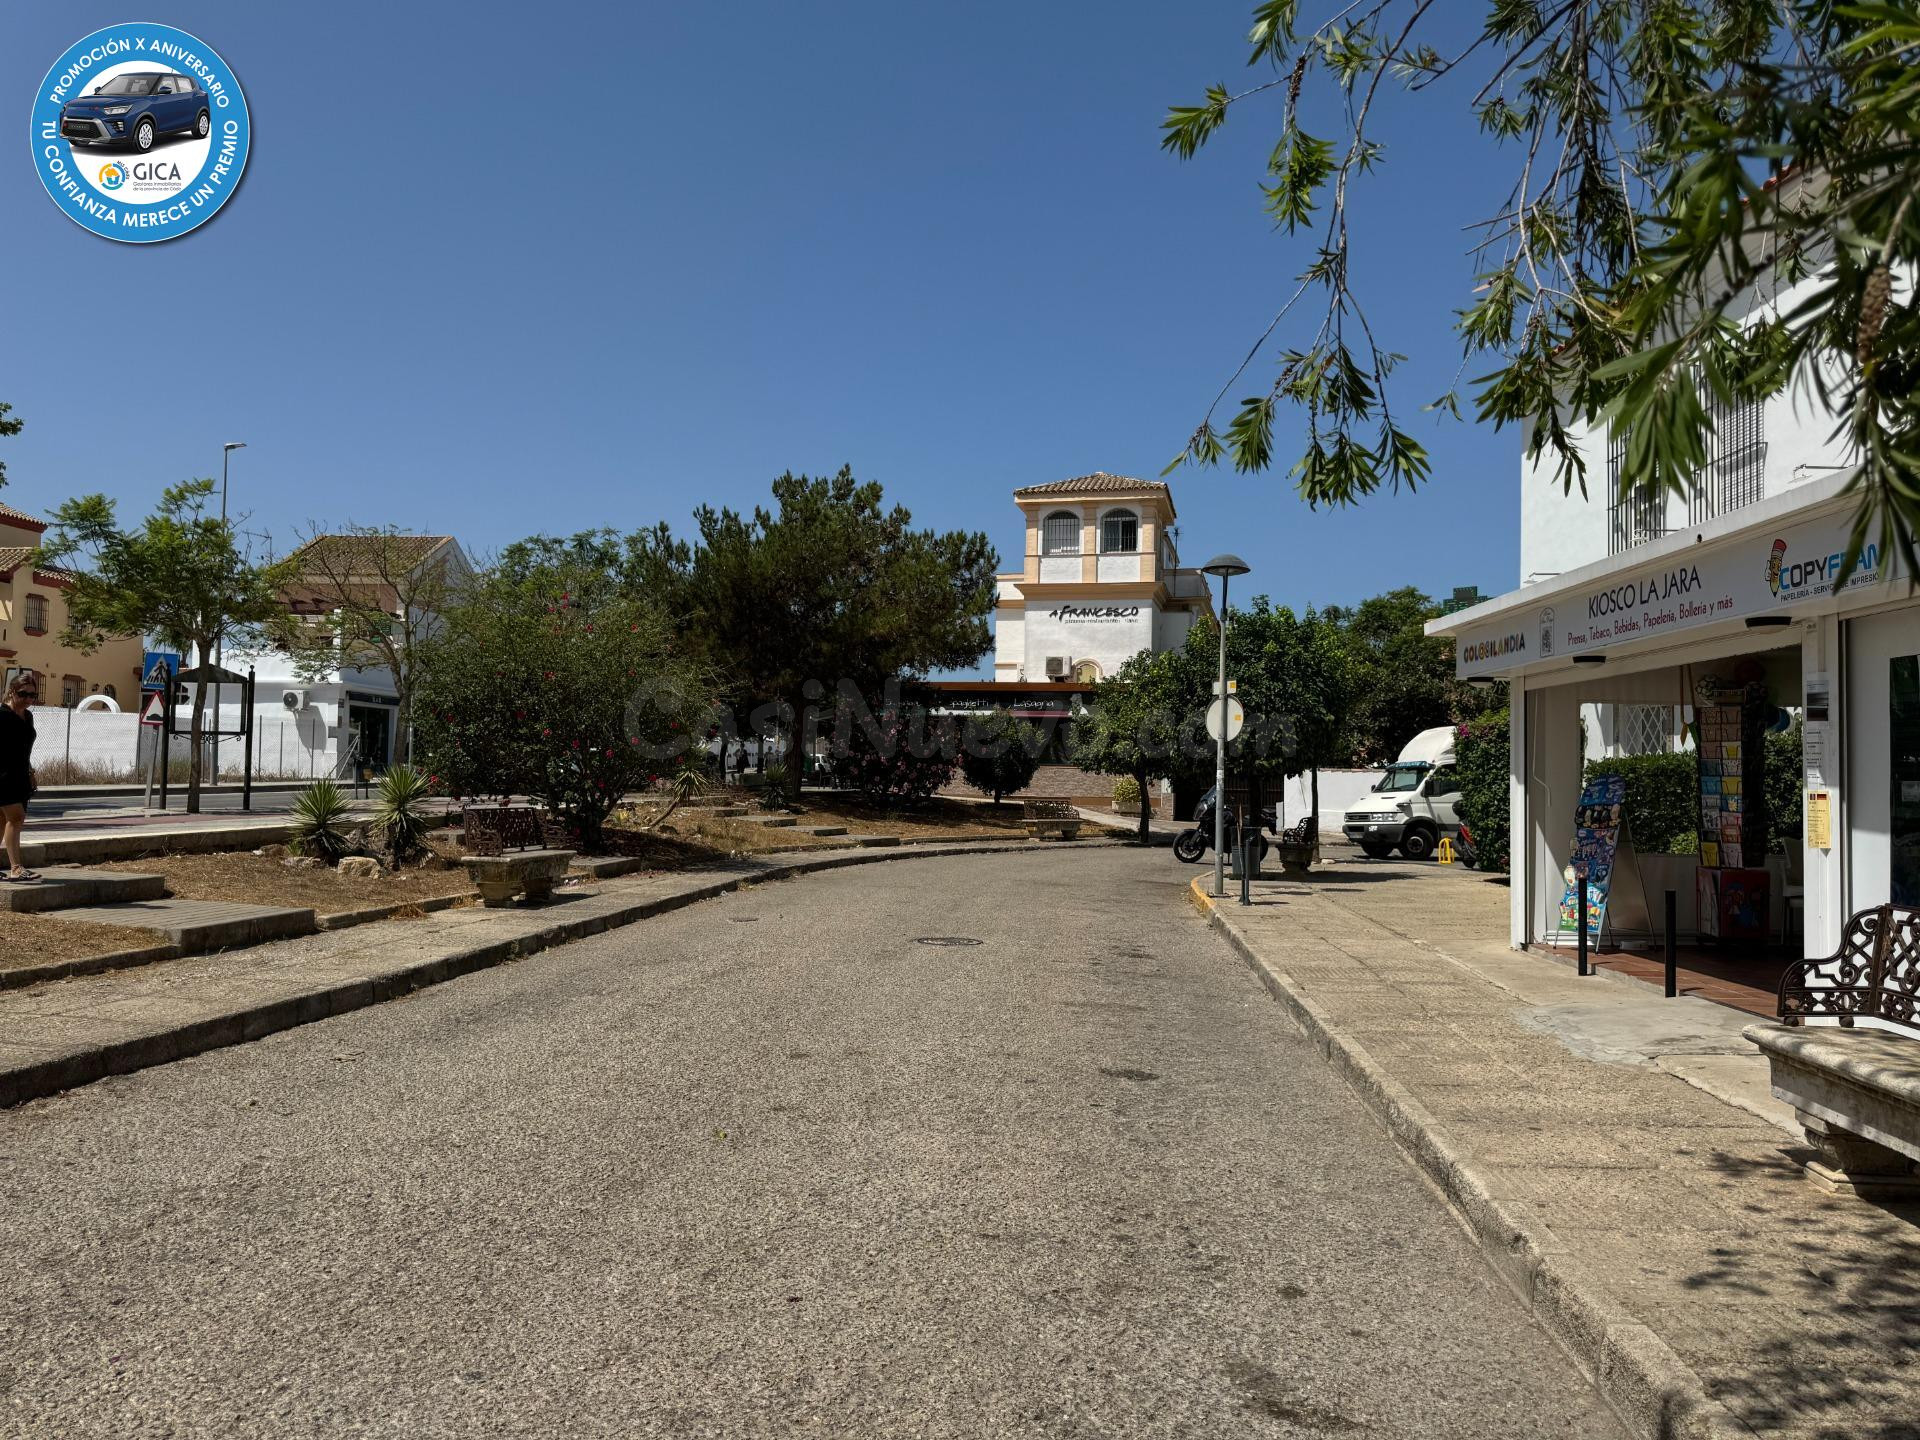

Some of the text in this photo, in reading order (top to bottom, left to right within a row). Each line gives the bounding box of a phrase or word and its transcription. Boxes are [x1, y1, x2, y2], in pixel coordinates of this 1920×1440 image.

[1779, 543, 1880, 591] COPYFAN
[1588, 565, 1702, 620] KIOSCO LA JARA
[1709, 601, 1715, 616] y
[1717, 594, 1733, 611] más
[1058, 605, 1139, 622] FRANCESCO
